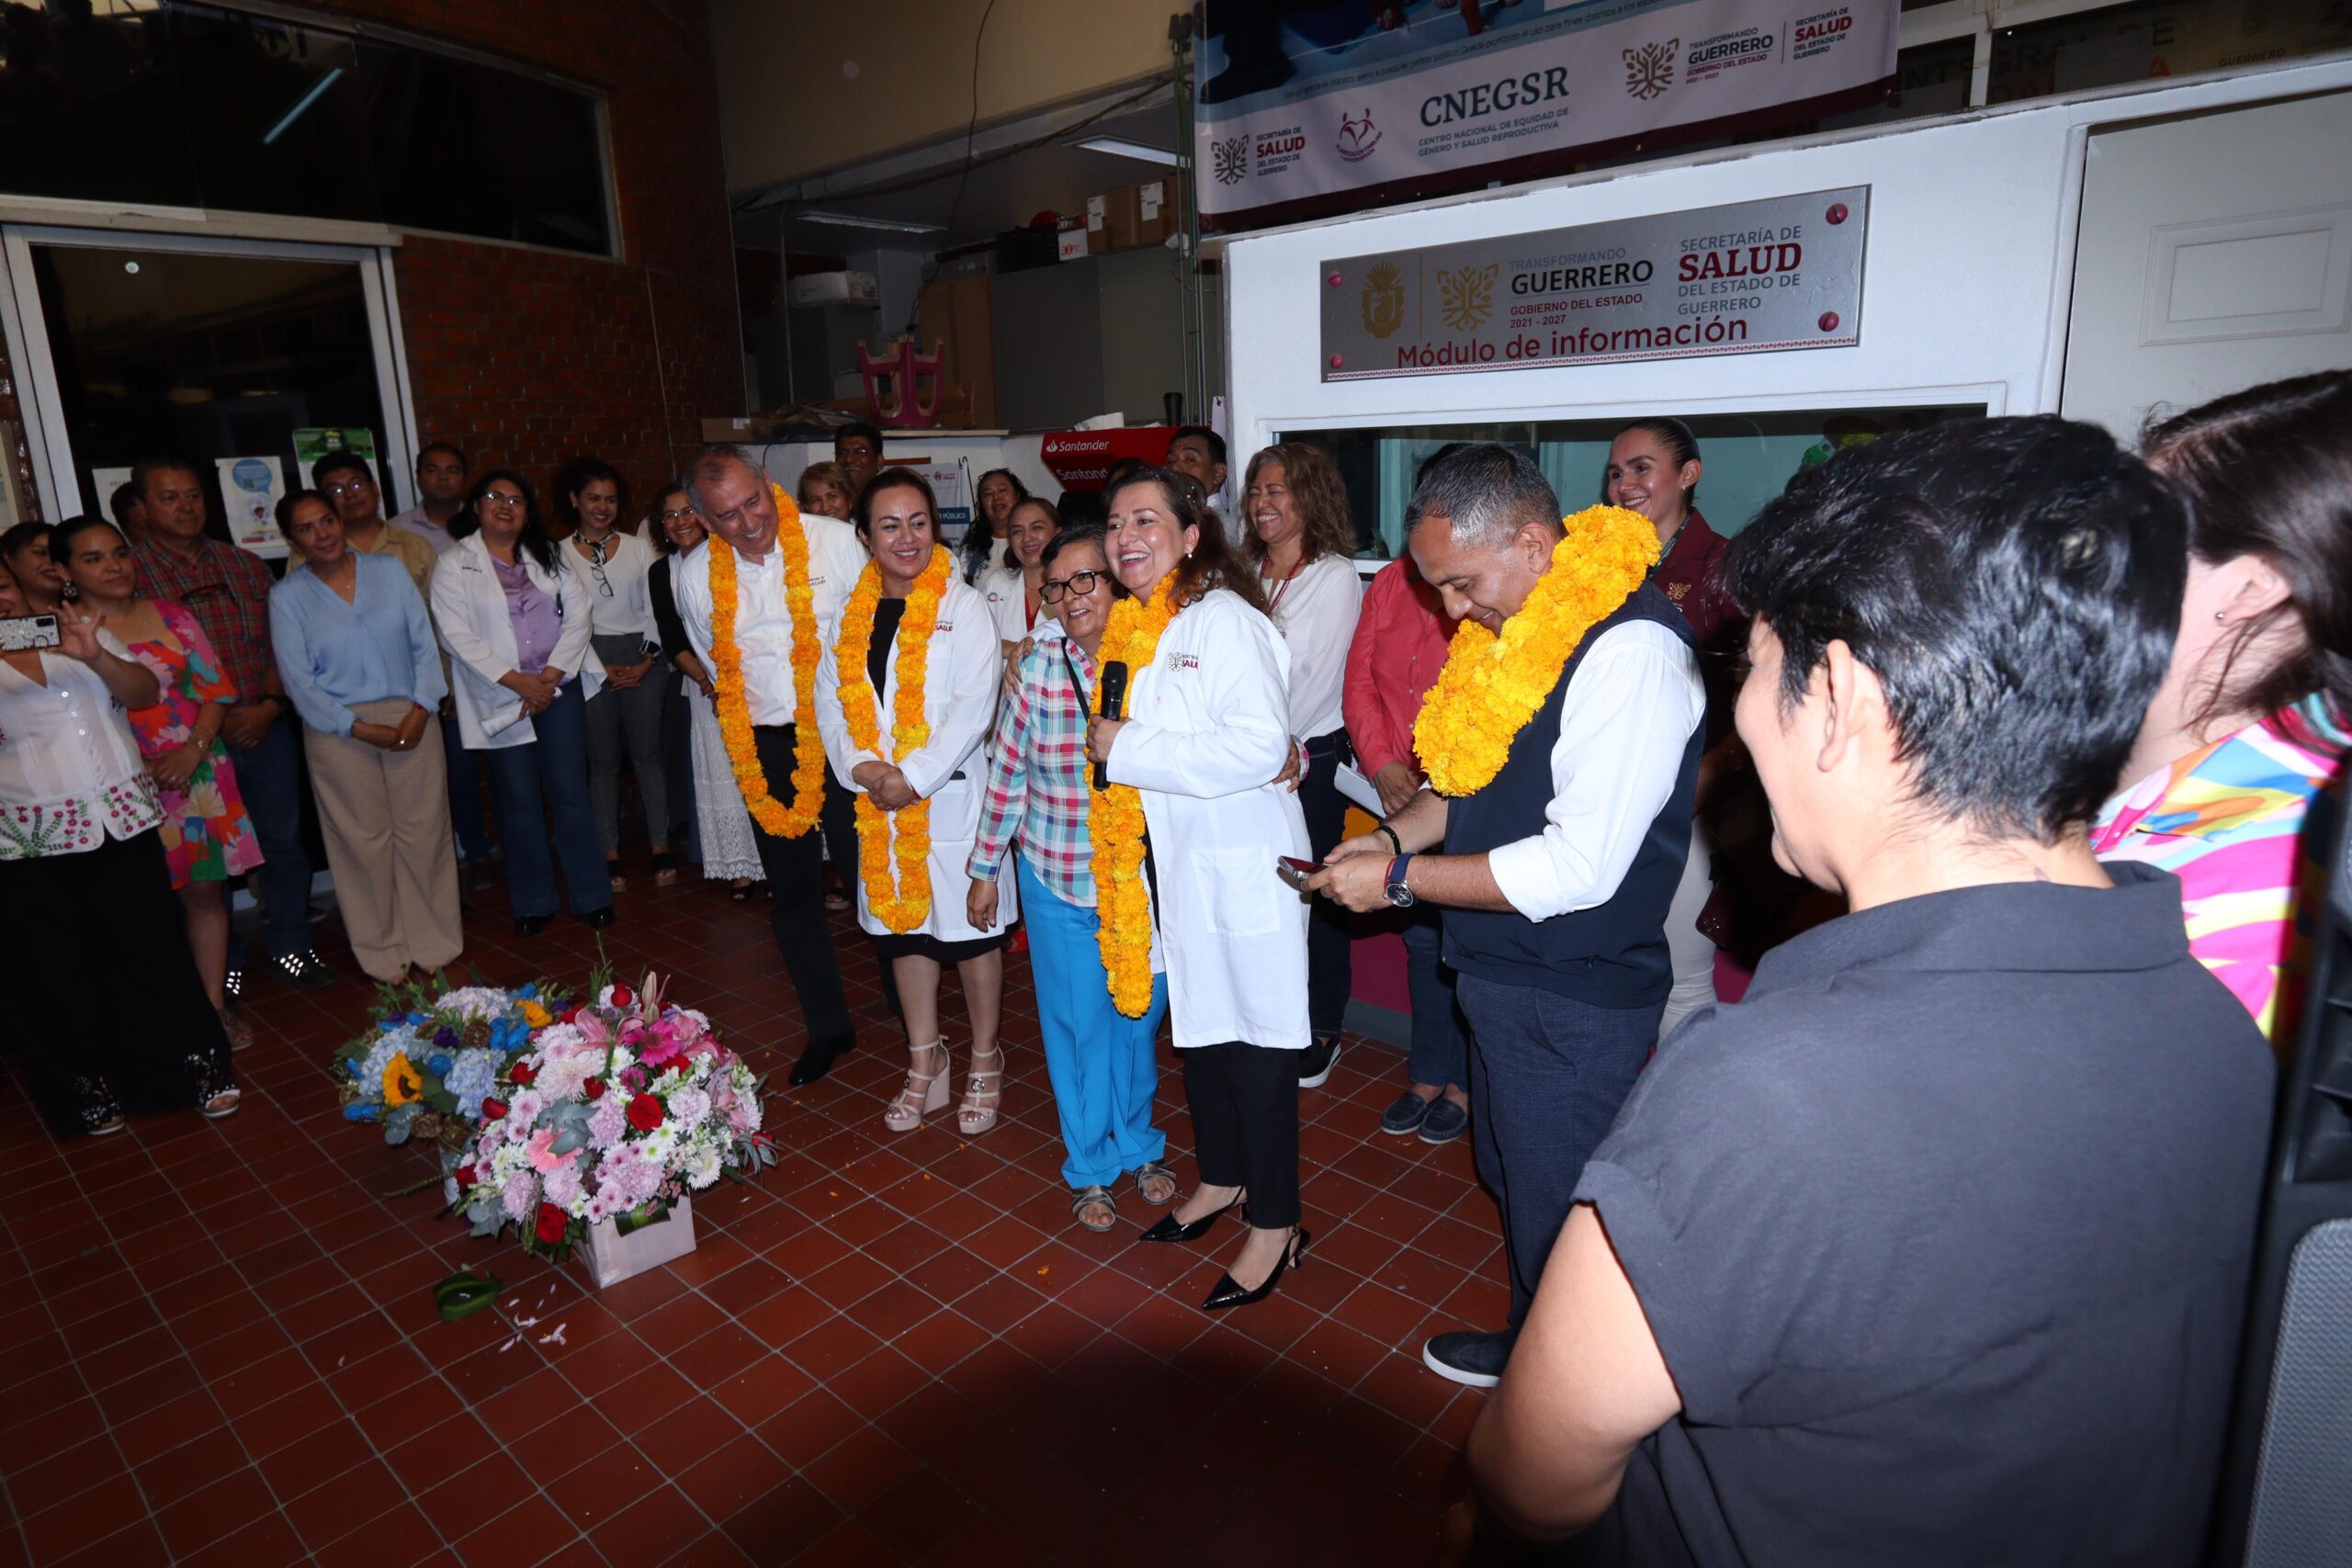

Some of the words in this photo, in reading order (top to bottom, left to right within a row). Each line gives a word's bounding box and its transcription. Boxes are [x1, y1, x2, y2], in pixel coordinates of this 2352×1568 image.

[1795, 10, 1838, 27] SECRETARÍA
[1839, 6, 1849, 15] DE
[1689, 28, 1758, 50] TRANSFORMANDO
[1794, 16, 1853, 42] SALUD
[1689, 35, 1773, 65] GUERRERO
[1792, 45, 1830, 61] GUERRERO
[1793, 43, 1806, 52] DEL
[1807, 36, 1836, 49] ESTADO
[1687, 62, 1722, 77] GOBIERNO
[1723, 60, 1737, 69] DEL
[1738, 53, 1768, 66] ESTADO
[2219, 48, 2286, 67] GUERRERO
[1420, 66, 1570, 127] CNEGSR
[1256, 127, 1292, 141] SECRETARÍA
[1294, 126, 1302, 134] DE
[1419, 132, 1452, 146] CENTRO
[1453, 123, 1498, 139] NACIONAL
[1499, 120, 1512, 130] DE
[1514, 110, 1555, 128] EQUIDAD
[1556, 107, 1569, 117] DE
[1419, 141, 1452, 156] GÉNERO
[1454, 141, 1460, 150] Y
[1462, 136, 1490, 148] SALUD
[1491, 120, 1559, 142] REPRODUCTIVA
[1256, 136, 1306, 158] SALUD
[1257, 159, 1267, 168] DEL
[1268, 155, 1293, 166] ESTADO
[1257, 165, 1288, 177] GUERRERO
[1680, 227, 1775, 253] SECRETARÍA
[1781, 226, 1802, 240] DE
[1510, 248, 1626, 272] TRANSFORMANDO
[1678, 242, 1802, 282] SALUD
[1511, 259, 1654, 296] GUERRERO
[1678, 284, 1705, 298] DEL
[1711, 276, 1774, 294] ESTADO
[1780, 274, 1801, 287] DE
[1510, 301, 1568, 317] GOBIERNO
[1570, 299, 1592, 310] DEL
[1595, 293, 1643, 308] ESTADO
[1678, 296, 1761, 316] GUERRERO
[1510, 318, 1531, 329] 2021
[1542, 315, 1566, 326] 2027
[1398, 338, 1496, 368] Módulo
[1505, 334, 1541, 359] de
[1552, 315, 1747, 356] información
[1058, 439, 1110, 452] Santander
[943, 511, 967, 521] PÚBLICO
